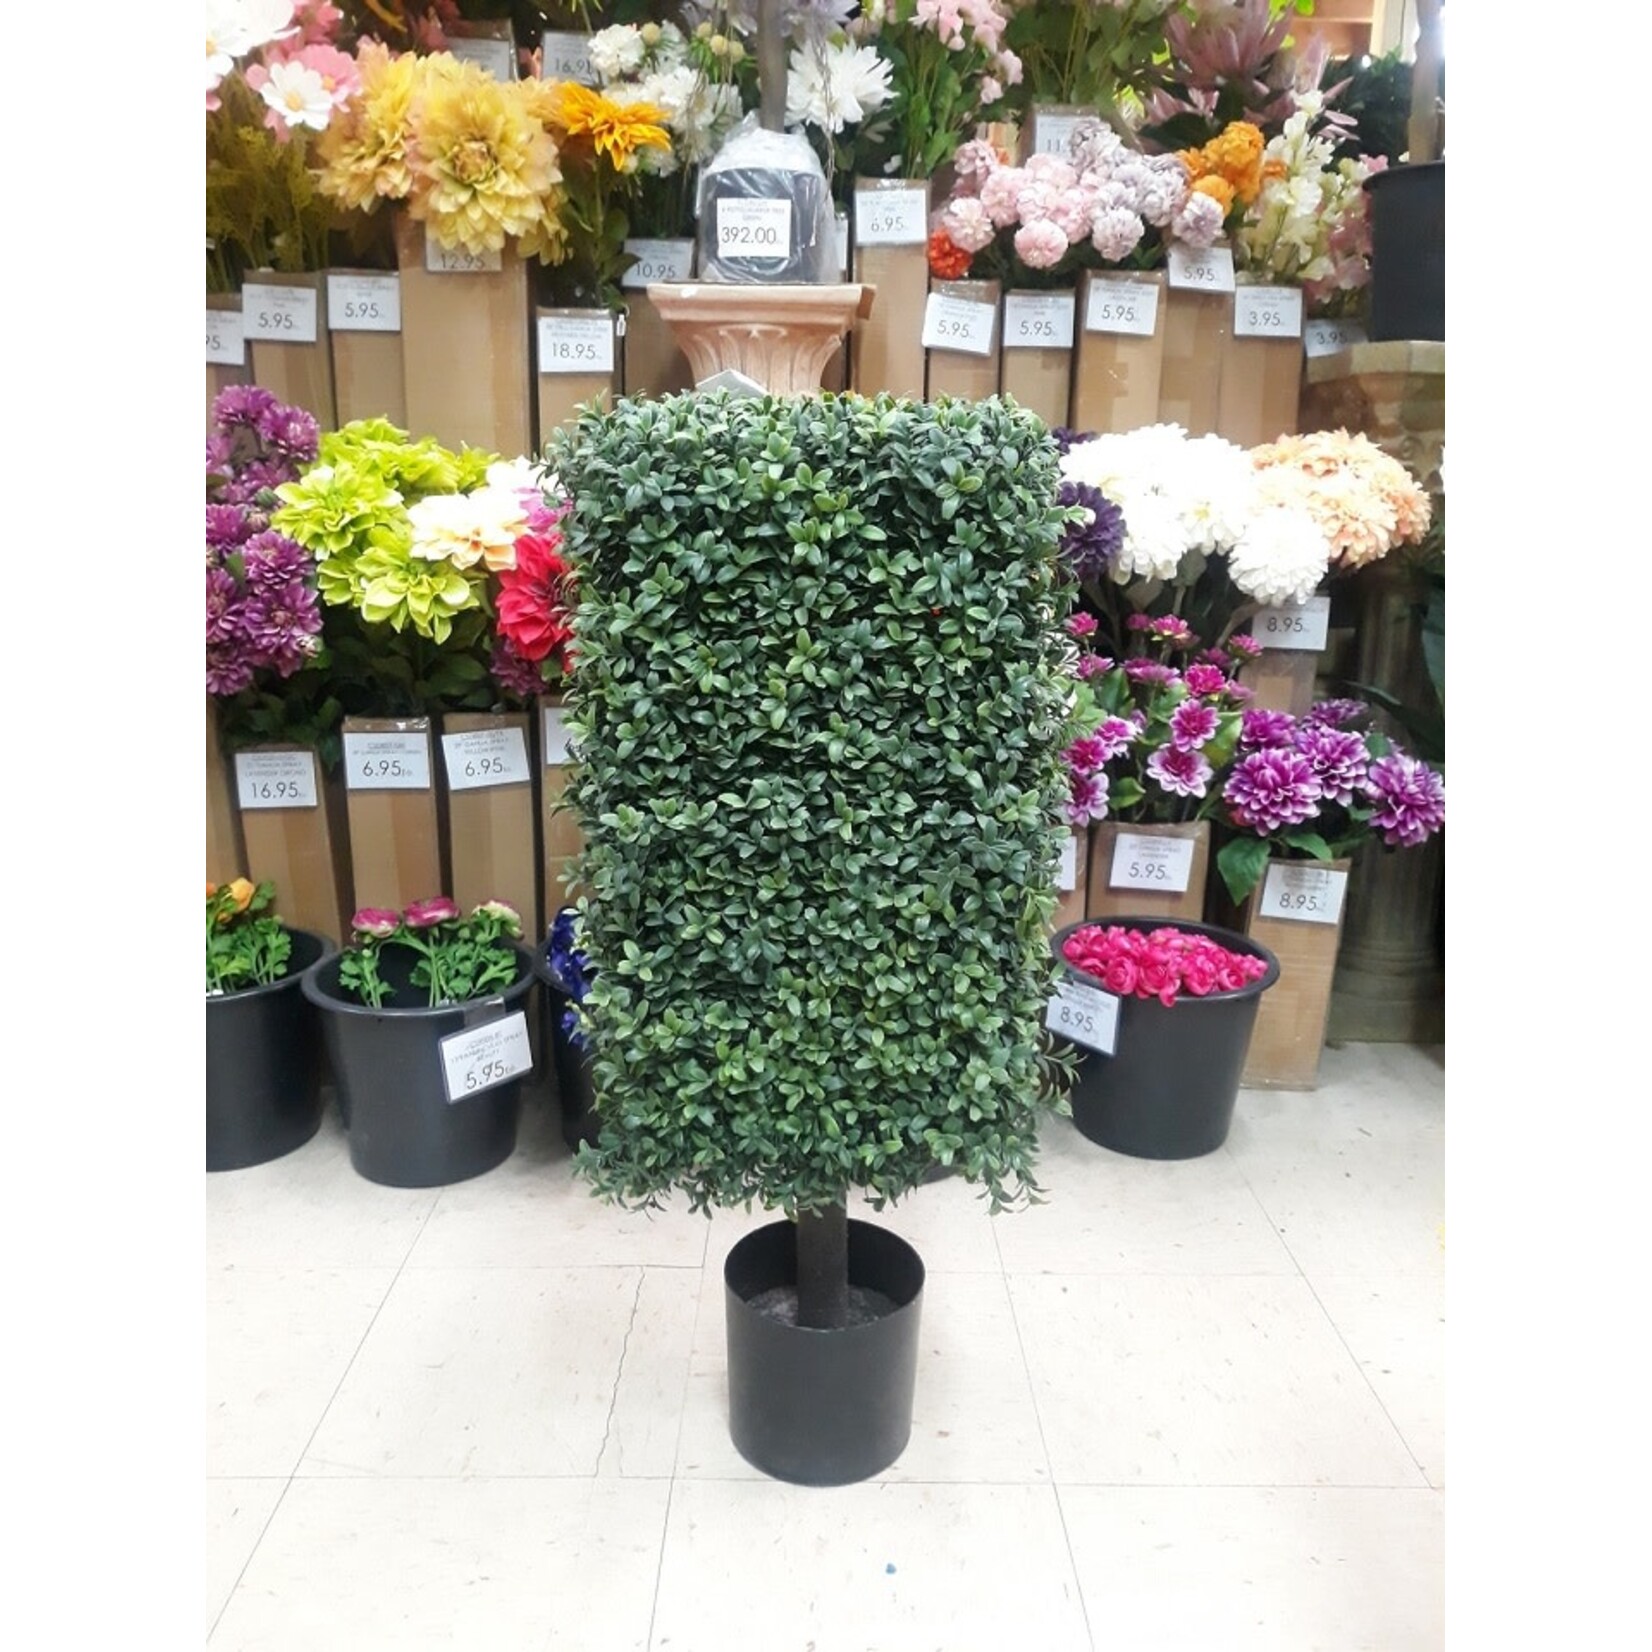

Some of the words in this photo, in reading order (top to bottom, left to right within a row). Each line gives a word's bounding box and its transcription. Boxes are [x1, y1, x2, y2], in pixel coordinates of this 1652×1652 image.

[871, 216, 904, 233] 6.95
[721, 226, 777, 245] 392.00
[440, 253, 485, 270] 12.95
[636, 262, 676, 279] 10.95
[1183, 265, 1215, 282] 5.95
[343, 301, 380, 319] 5.95
[1100, 304, 1135, 322] 5.95
[1249, 310, 1281, 327] 3.95
[257, 311, 294, 330] 5.95
[936, 319, 970, 338] 5.95
[1019, 320, 1053, 337] 5.95
[552, 342, 597, 360] 18.95
[1266, 616, 1304, 633] 8.95
[362, 759, 402, 778] 6.95
[464, 756, 504, 777] 6.95
[251, 781, 299, 800] 16.95
[1128, 861, 1167, 882] 5.95
[1279, 892, 1317, 911] 8.95
[1060, 1005, 1094, 1033] 8.95
[466, 1059, 505, 1090] 5.95
